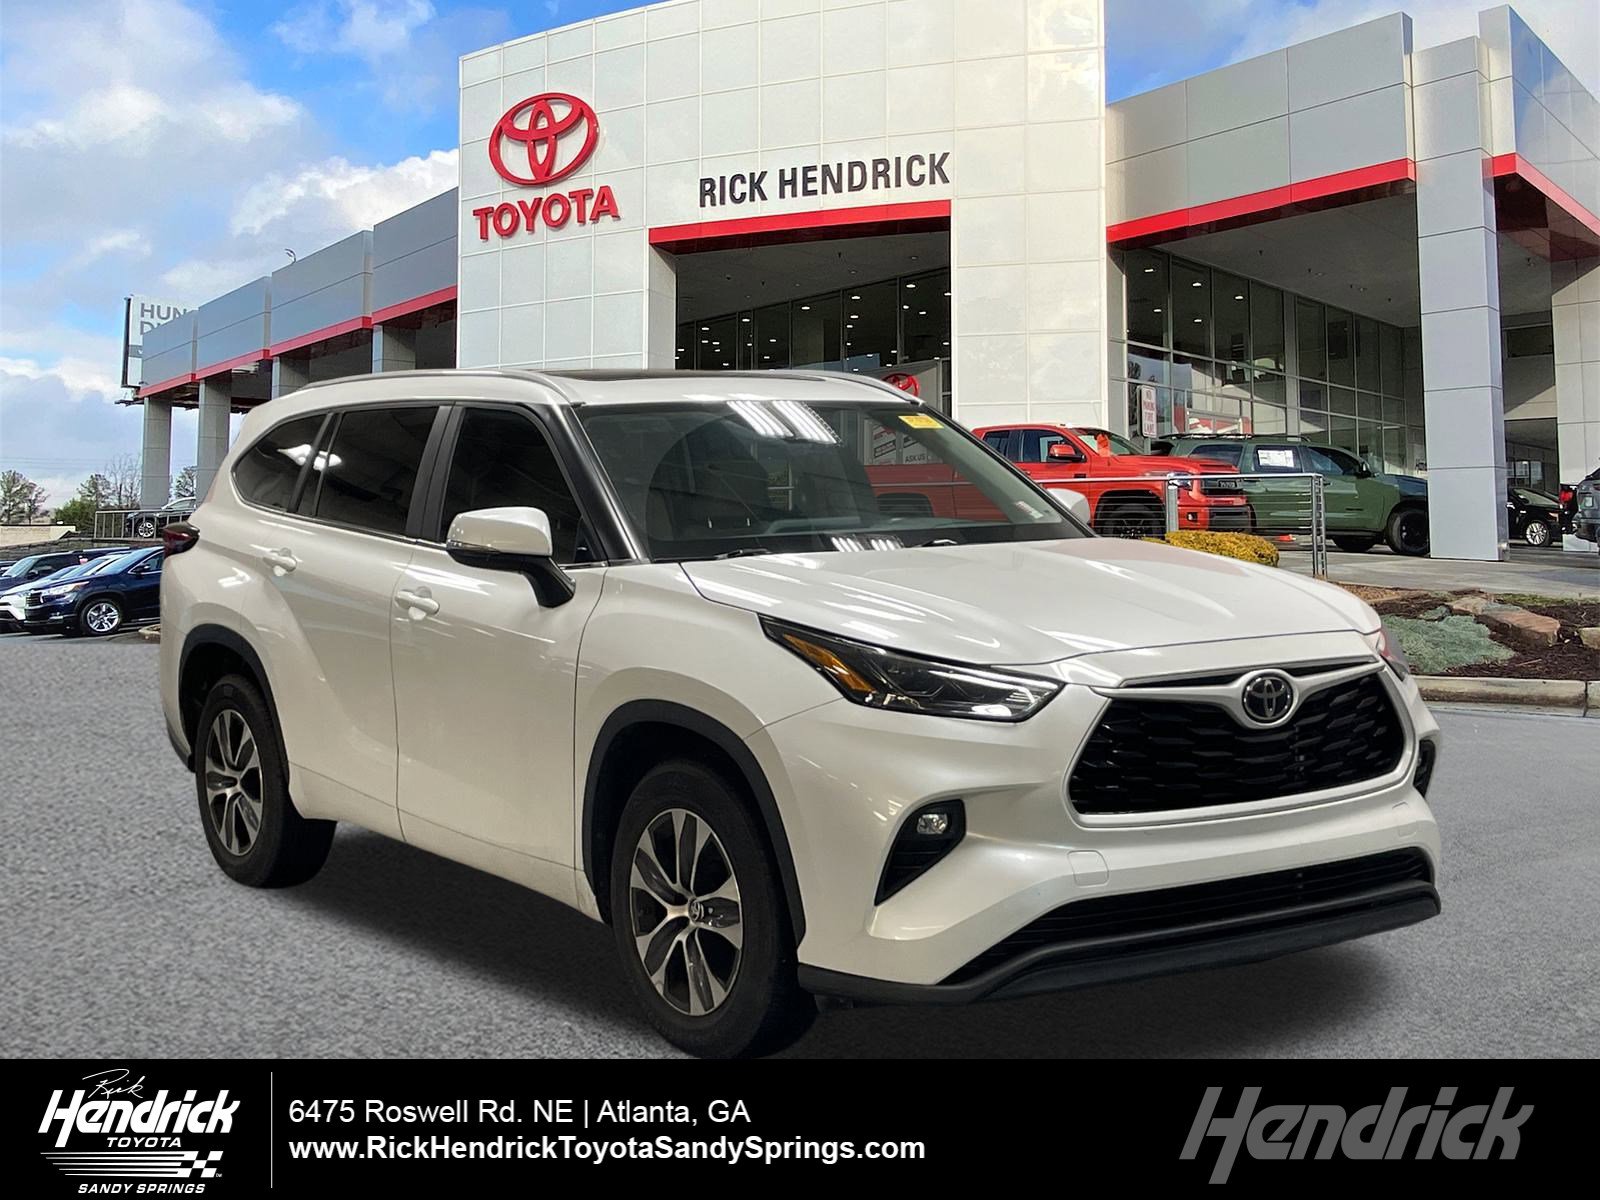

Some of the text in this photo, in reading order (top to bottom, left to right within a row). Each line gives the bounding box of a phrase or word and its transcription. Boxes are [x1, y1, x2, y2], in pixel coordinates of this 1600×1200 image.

[699, 152, 951, 208] RICK HENDRICK
[473, 185, 621, 240] TOYOTA
